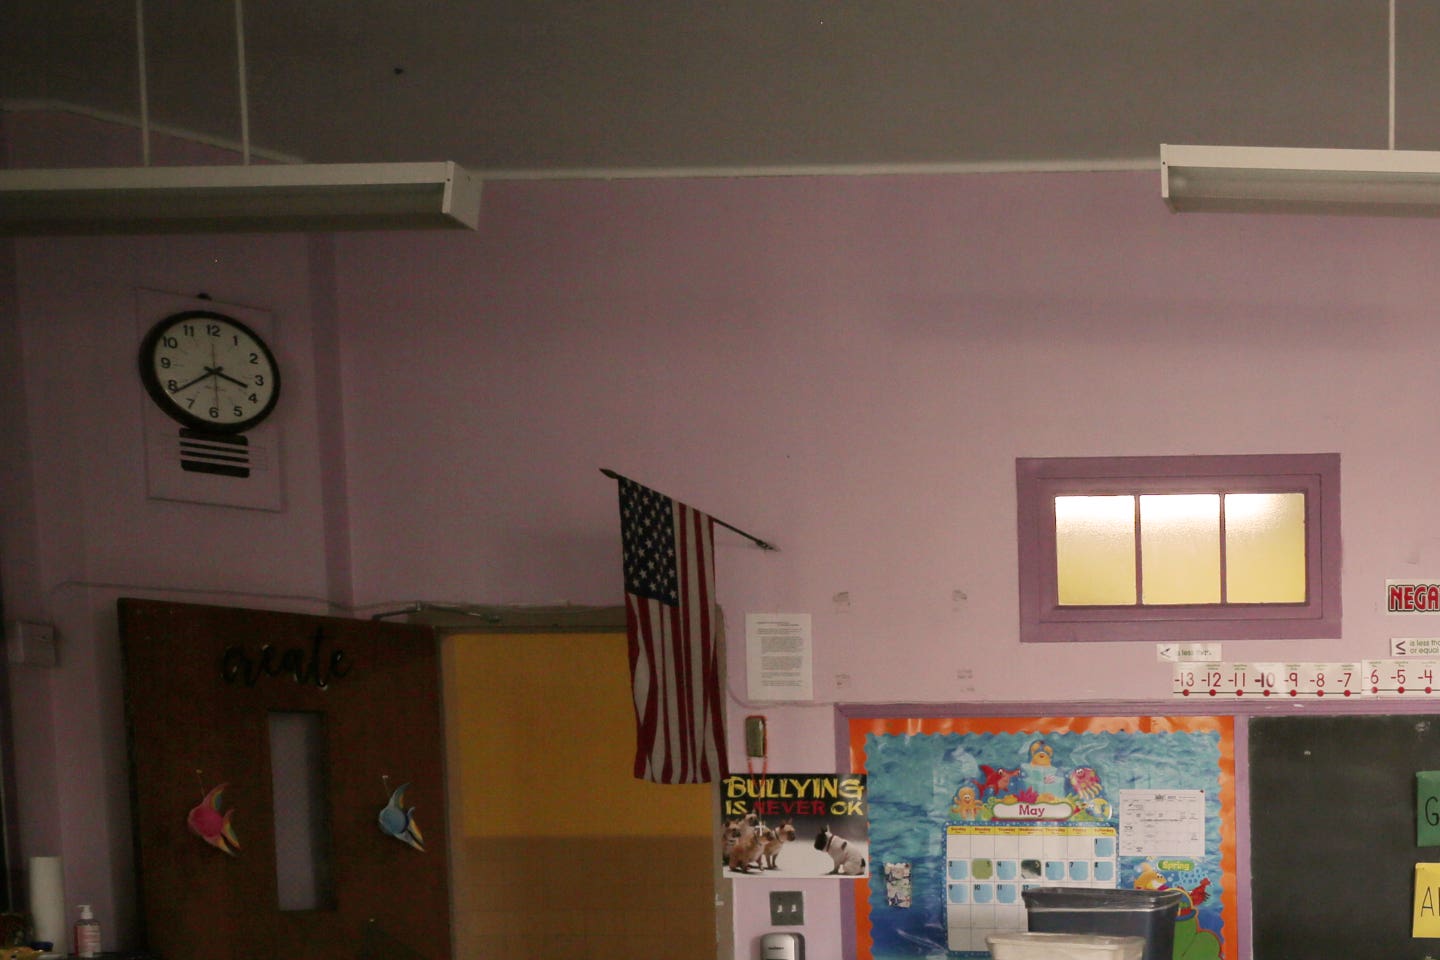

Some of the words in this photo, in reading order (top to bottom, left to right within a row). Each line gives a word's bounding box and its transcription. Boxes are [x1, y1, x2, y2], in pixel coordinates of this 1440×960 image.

[183, 325, 195, 337] 11
[206, 325, 221, 337] 12
[163, 336, 178, 349] 10
[233, 336, 239, 346] 1
[160, 357, 170, 368] 9
[250, 353, 259, 364] 2
[168, 379, 178, 392] 8
[255, 375, 264, 386] 3
[187, 399, 196, 409] 7
[248, 393, 257, 404] 4
[209, 407, 219, 418] 6
[233, 406, 243, 417] 5
[1174, 672, 1194, 687] -13
[1201, 672, 1221, 687] -12
[1228, 672, 1246, 687] -11
[1254, 672, 1275, 688] -10
[1284, 672, 1298, 687] -9
[1309, 672, 1325, 687] -8
[1337, 672, 1352, 687] -7
[1391, 669, 1406, 685] -5
[1418, 669, 1432, 685] -4
[723, 776, 864, 800] BULLYING
[725, 800, 747, 815] IS
[752, 800, 826, 815] NEVER
[830, 800, 863, 815] OK
[1018, 804, 1045, 817] May
[1162, 861, 1190, 871] Spring
